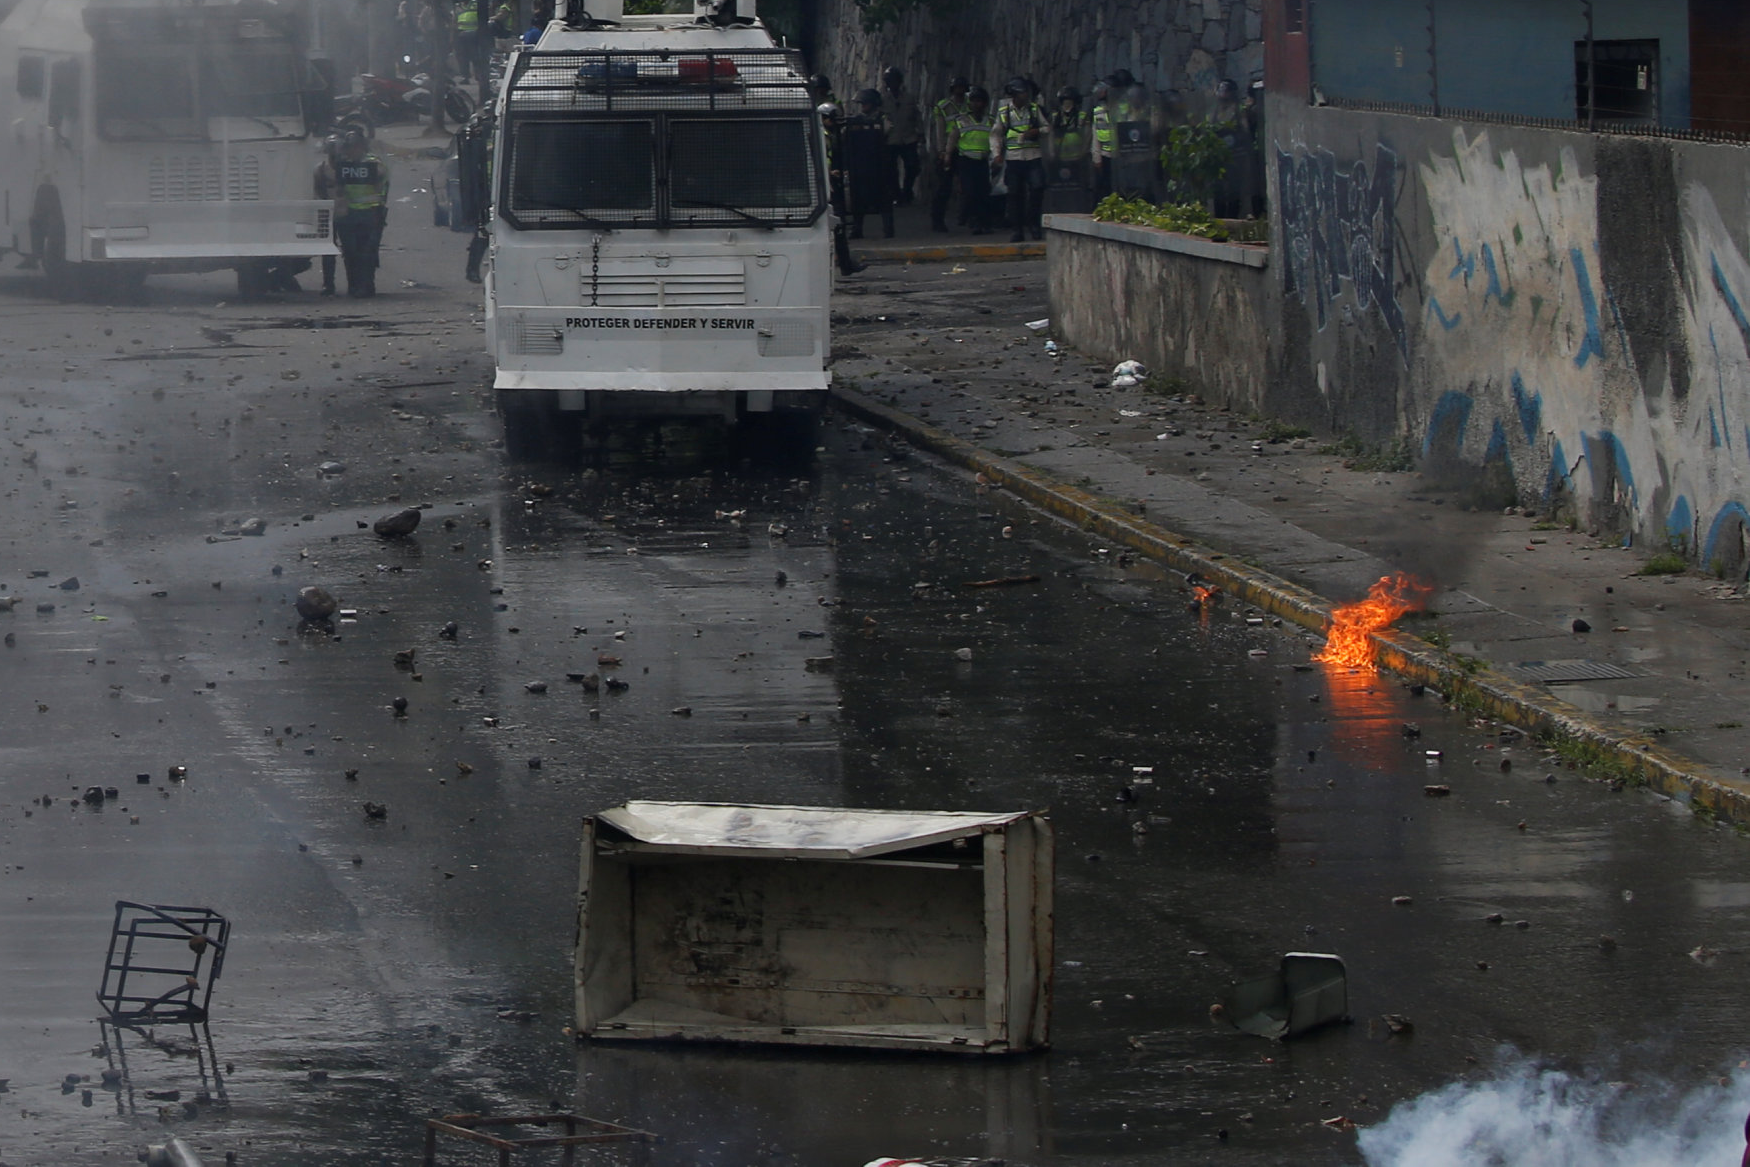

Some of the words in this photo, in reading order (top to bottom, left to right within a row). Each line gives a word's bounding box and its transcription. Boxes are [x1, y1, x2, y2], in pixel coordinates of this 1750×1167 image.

[341, 167, 369, 178] PNB
[566, 318, 630, 329] PROTEGER
[634, 318, 696, 329] DEFENDER
[700, 318, 708, 329] Y
[711, 318, 754, 330] SERVIR
